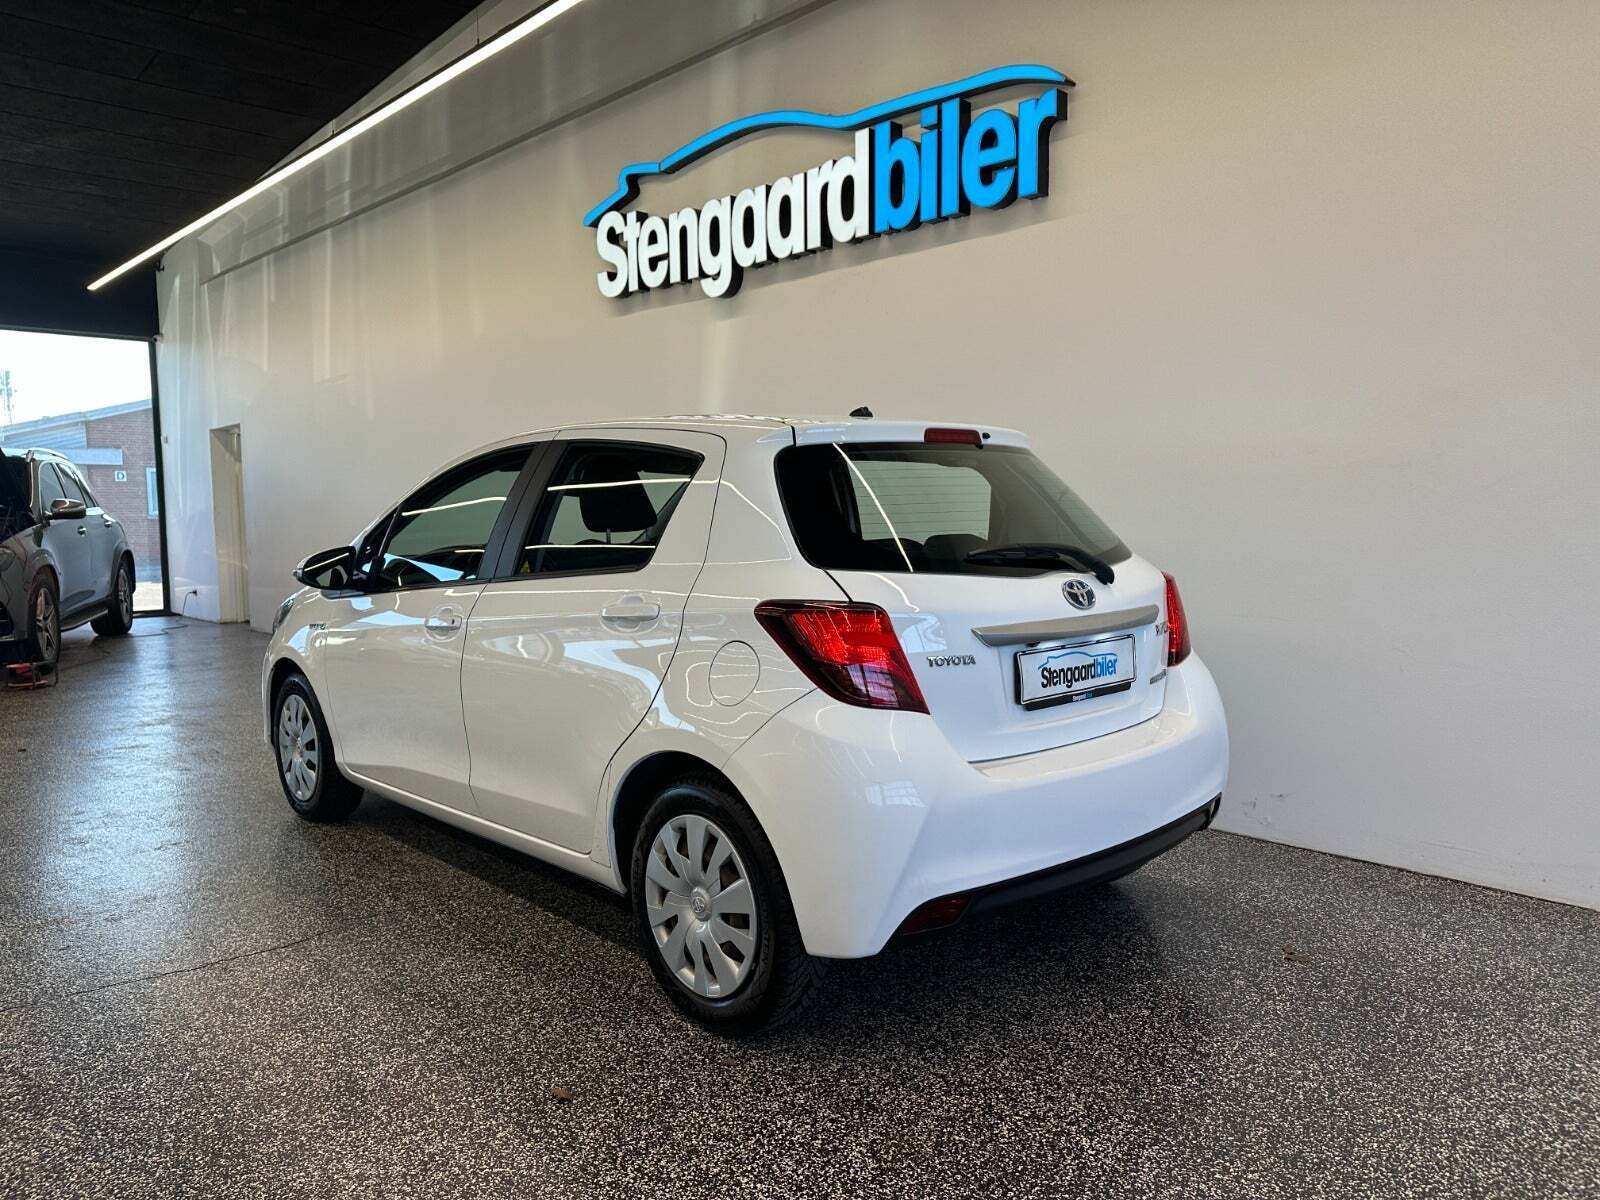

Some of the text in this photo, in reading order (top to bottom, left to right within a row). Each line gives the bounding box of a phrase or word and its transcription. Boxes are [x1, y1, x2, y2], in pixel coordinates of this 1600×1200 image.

[596, 88, 1060, 298] Stengaardbiler
[116, 471, 125, 480] D
[927, 654, 977, 667] TOYOTA
[1041, 658, 1118, 688] Stengaardbiler
